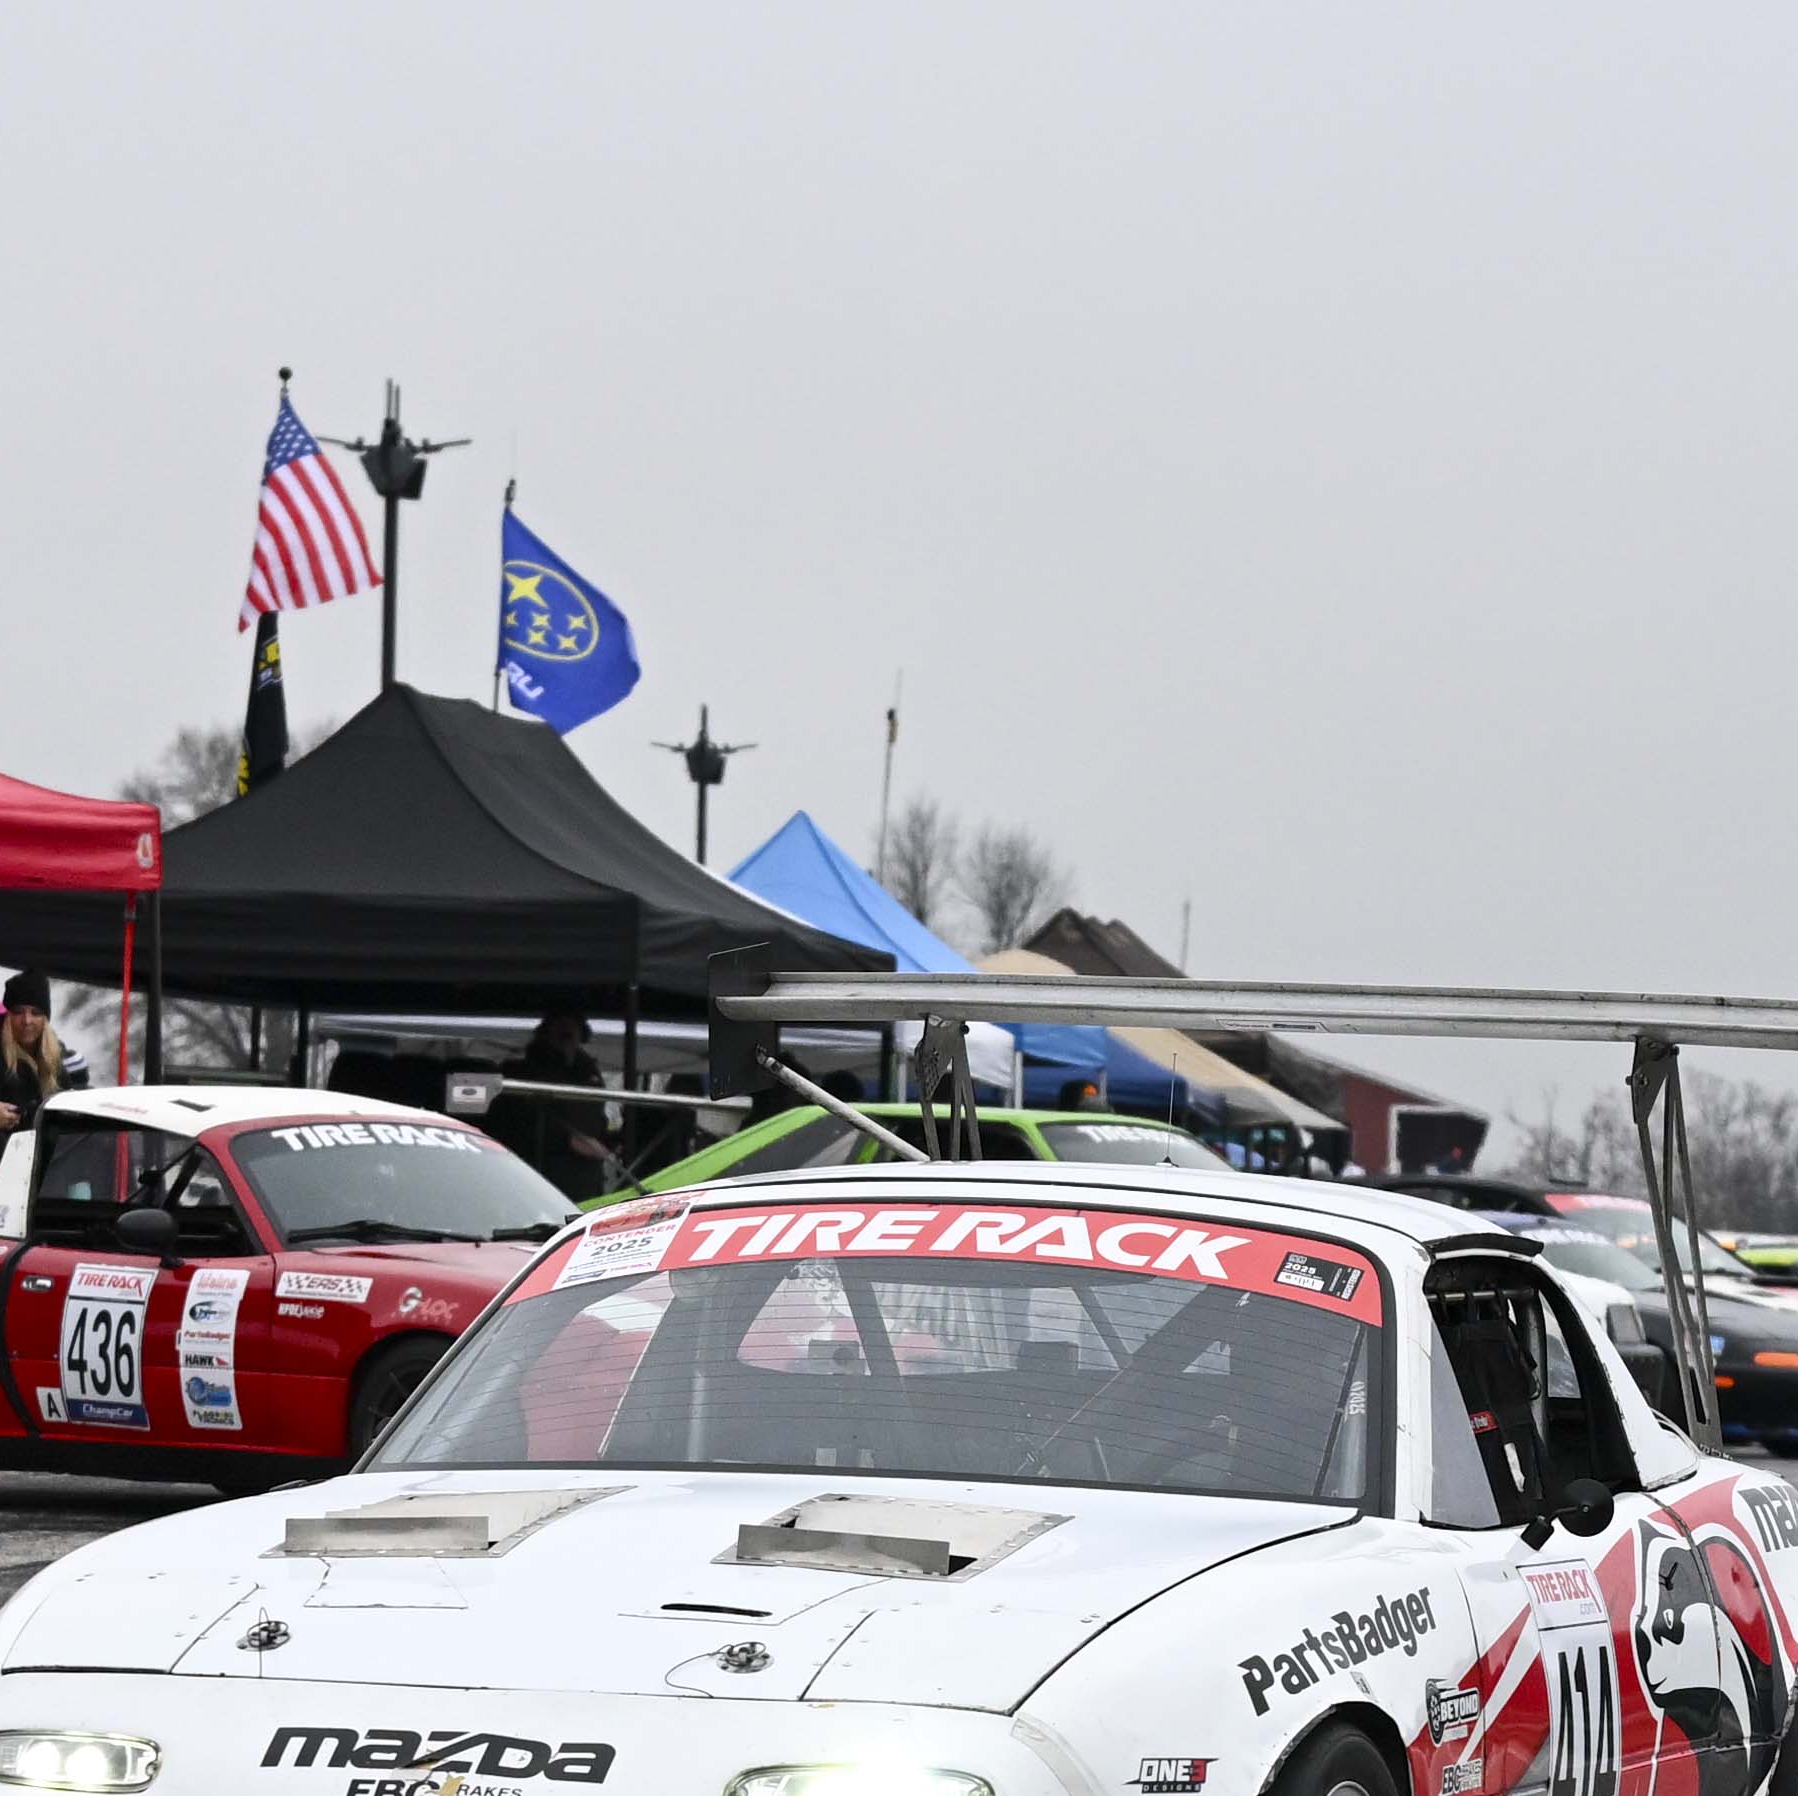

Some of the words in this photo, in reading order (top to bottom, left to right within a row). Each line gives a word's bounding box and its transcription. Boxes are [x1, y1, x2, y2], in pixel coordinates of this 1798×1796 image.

[271, 1122, 377, 1151] TIRE
[369, 1123, 483, 1153] RACK
[584, 1223, 677, 1248] CONTENDER
[591, 1236, 653, 1257] 2025
[689, 1209, 939, 1262] TIRE
[928, 1210, 1254, 1281] RACK
[1284, 1262, 1317, 1275] 2025
[77, 1272, 107, 1287] TIRE
[107, 1274, 146, 1298] RACK
[67, 1307, 136, 1398] 436
[185, 1354, 214, 1367] HAWK
[47, 1392, 61, 1418] A
[1526, 1572, 1560, 1605] TIRE
[1558, 1567, 1602, 1614] RACK
[1237, 1586, 1436, 1717] PartsBadger
[1439, 1692, 1478, 1722] BEYOND
[1143, 1784, 1201, 1793] DESIGNS
[1442, 1764, 1461, 1795] EBC
